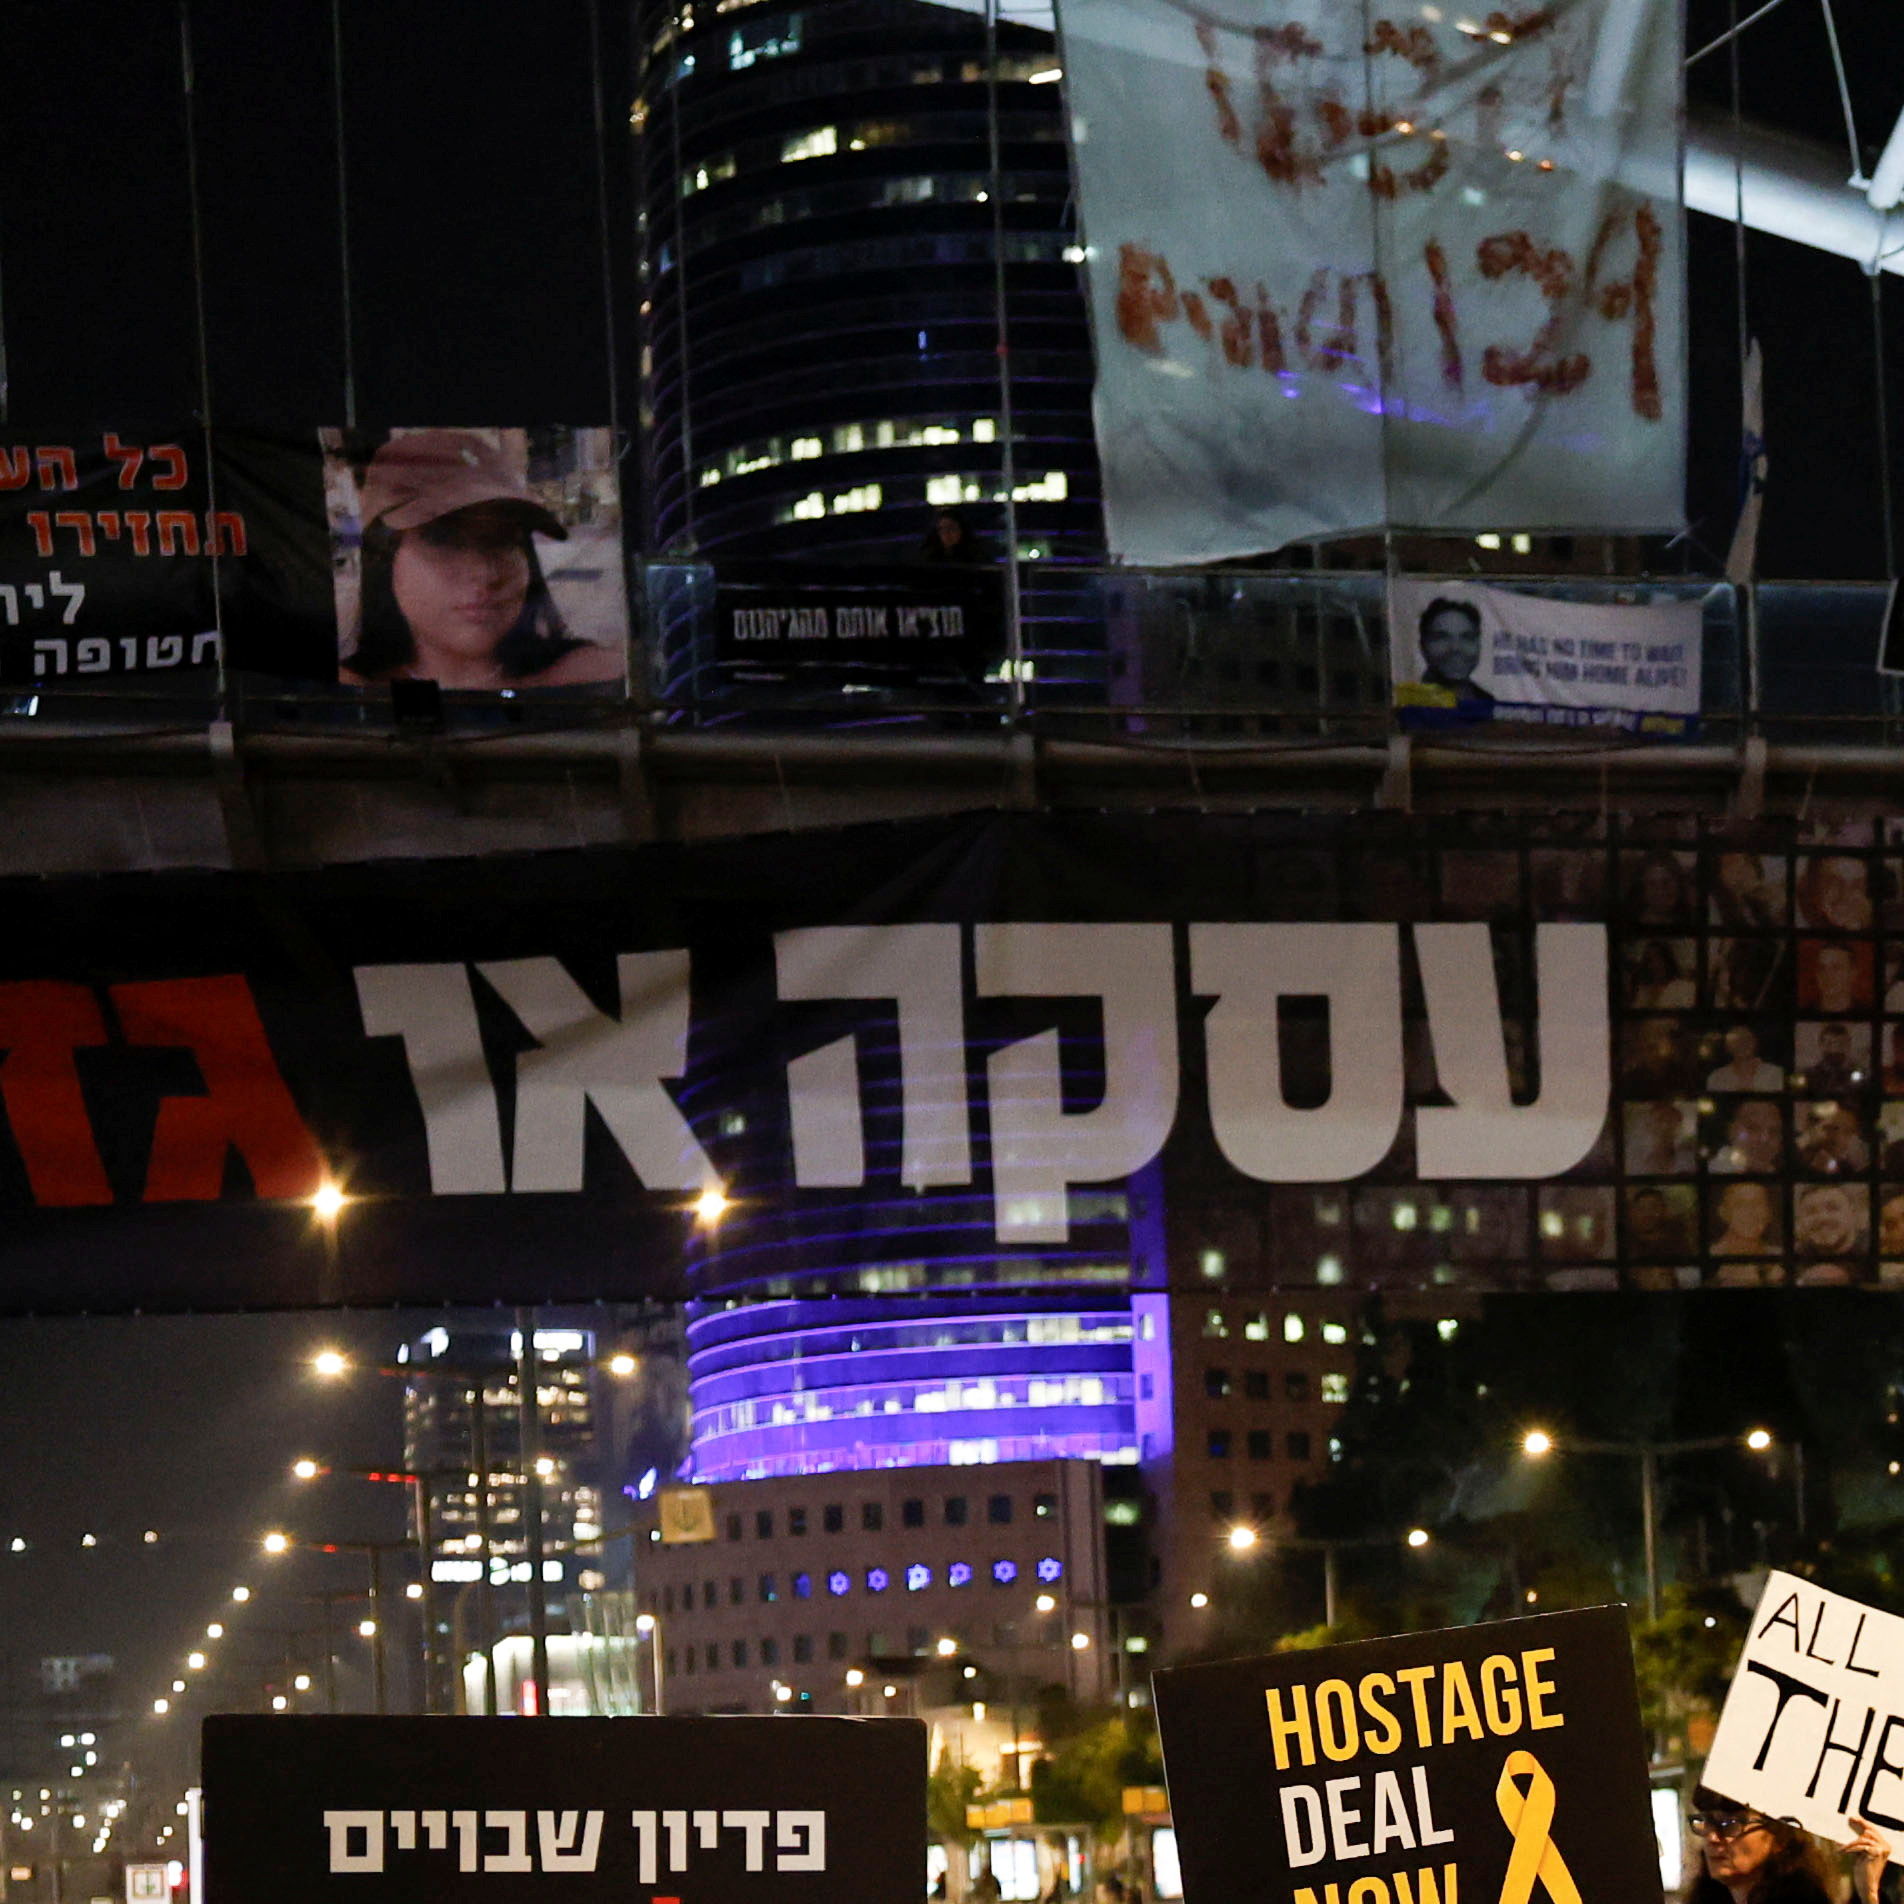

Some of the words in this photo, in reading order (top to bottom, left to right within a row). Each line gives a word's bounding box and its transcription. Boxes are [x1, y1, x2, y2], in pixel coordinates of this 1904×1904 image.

[103, 432, 188, 490] כל
[26, 510, 248, 558] תחזירו
[33, 630, 221, 676] חטופה
[354, 951, 716, 1196] או
[777, 924, 1609, 1243] עסקה
[1757, 1592, 1880, 1678] ALL
[1265, 1647, 1565, 1771] HOSTAGE
[323, 1810, 605, 1873] שבויים
[631, 1810, 826, 1884] פדיון
[1279, 1765, 1455, 1868] DEAL
